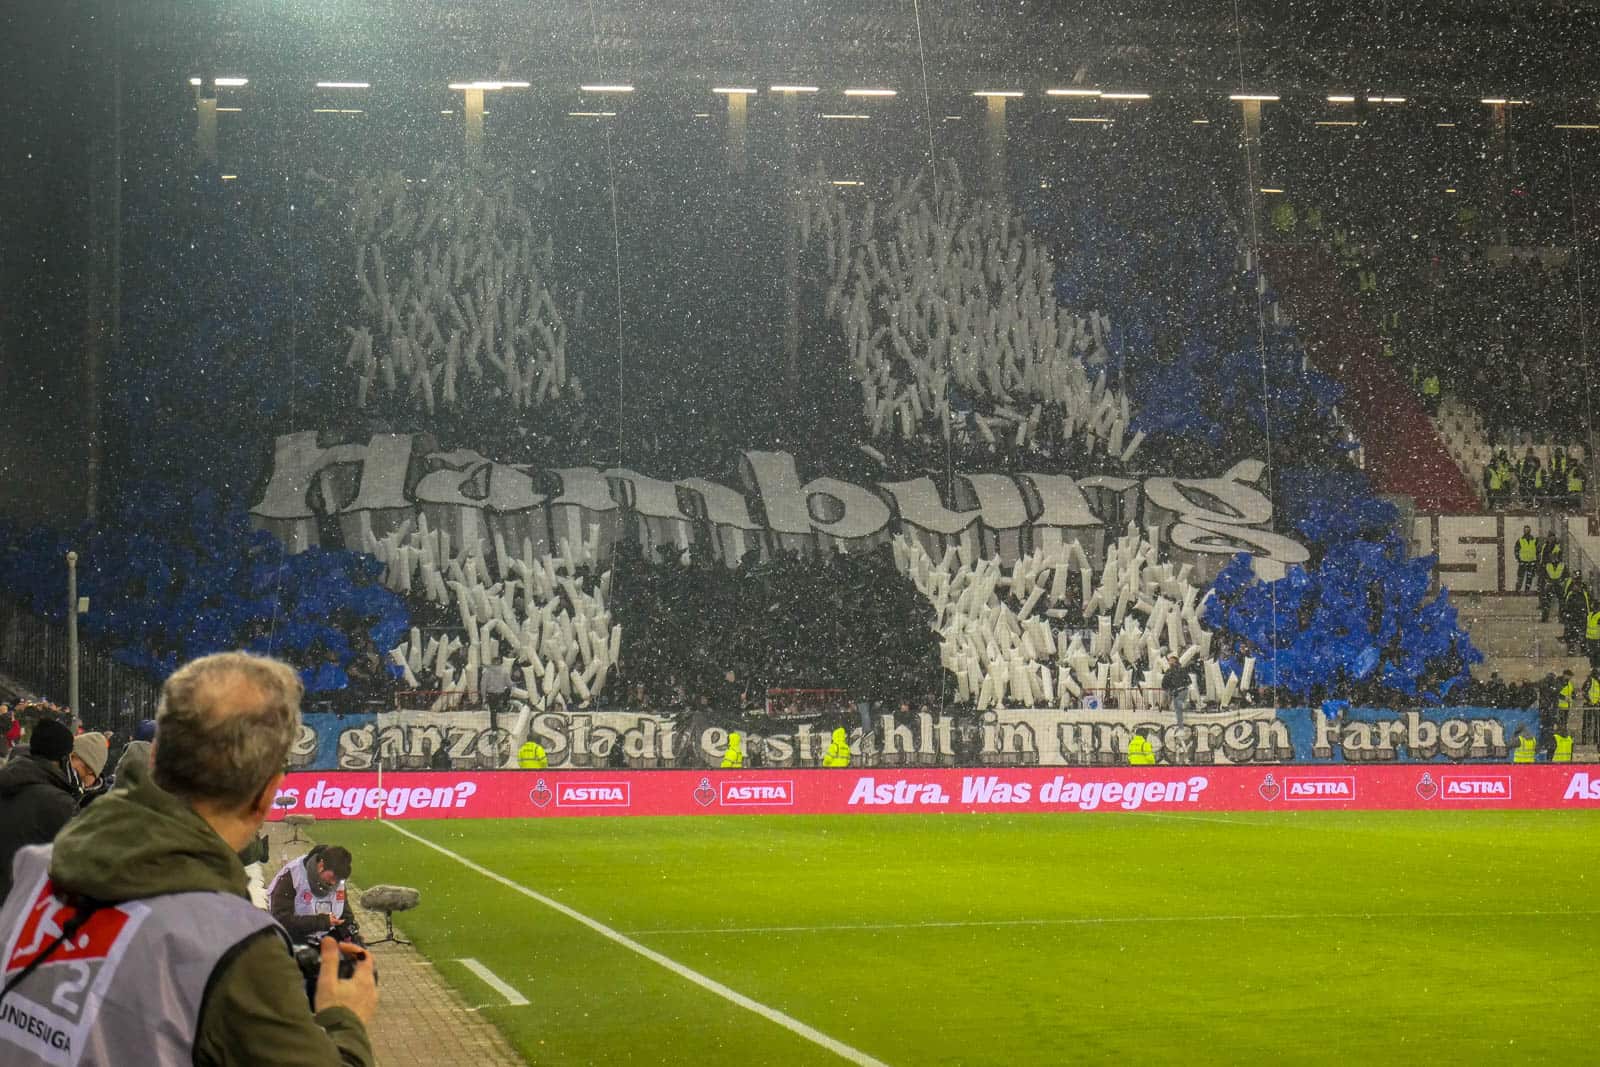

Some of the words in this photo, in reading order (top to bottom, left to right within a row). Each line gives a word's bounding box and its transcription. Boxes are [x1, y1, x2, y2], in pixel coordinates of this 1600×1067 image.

[248, 432, 1309, 579] Hamburg
[531, 713, 677, 763] Stadt
[978, 711, 1036, 758] in
[1313, 709, 1506, 755] Farben
[304, 779, 477, 816] dagegen?
[562, 787, 625, 802] ASTRA
[726, 785, 787, 800] ASTRA
[847, 777, 950, 805] Astra.
[961, 776, 1033, 804] Was
[1039, 775, 1209, 811] dagegen?
[1289, 781, 1350, 796] ASTRA
[1446, 780, 1506, 795] ASTRA
